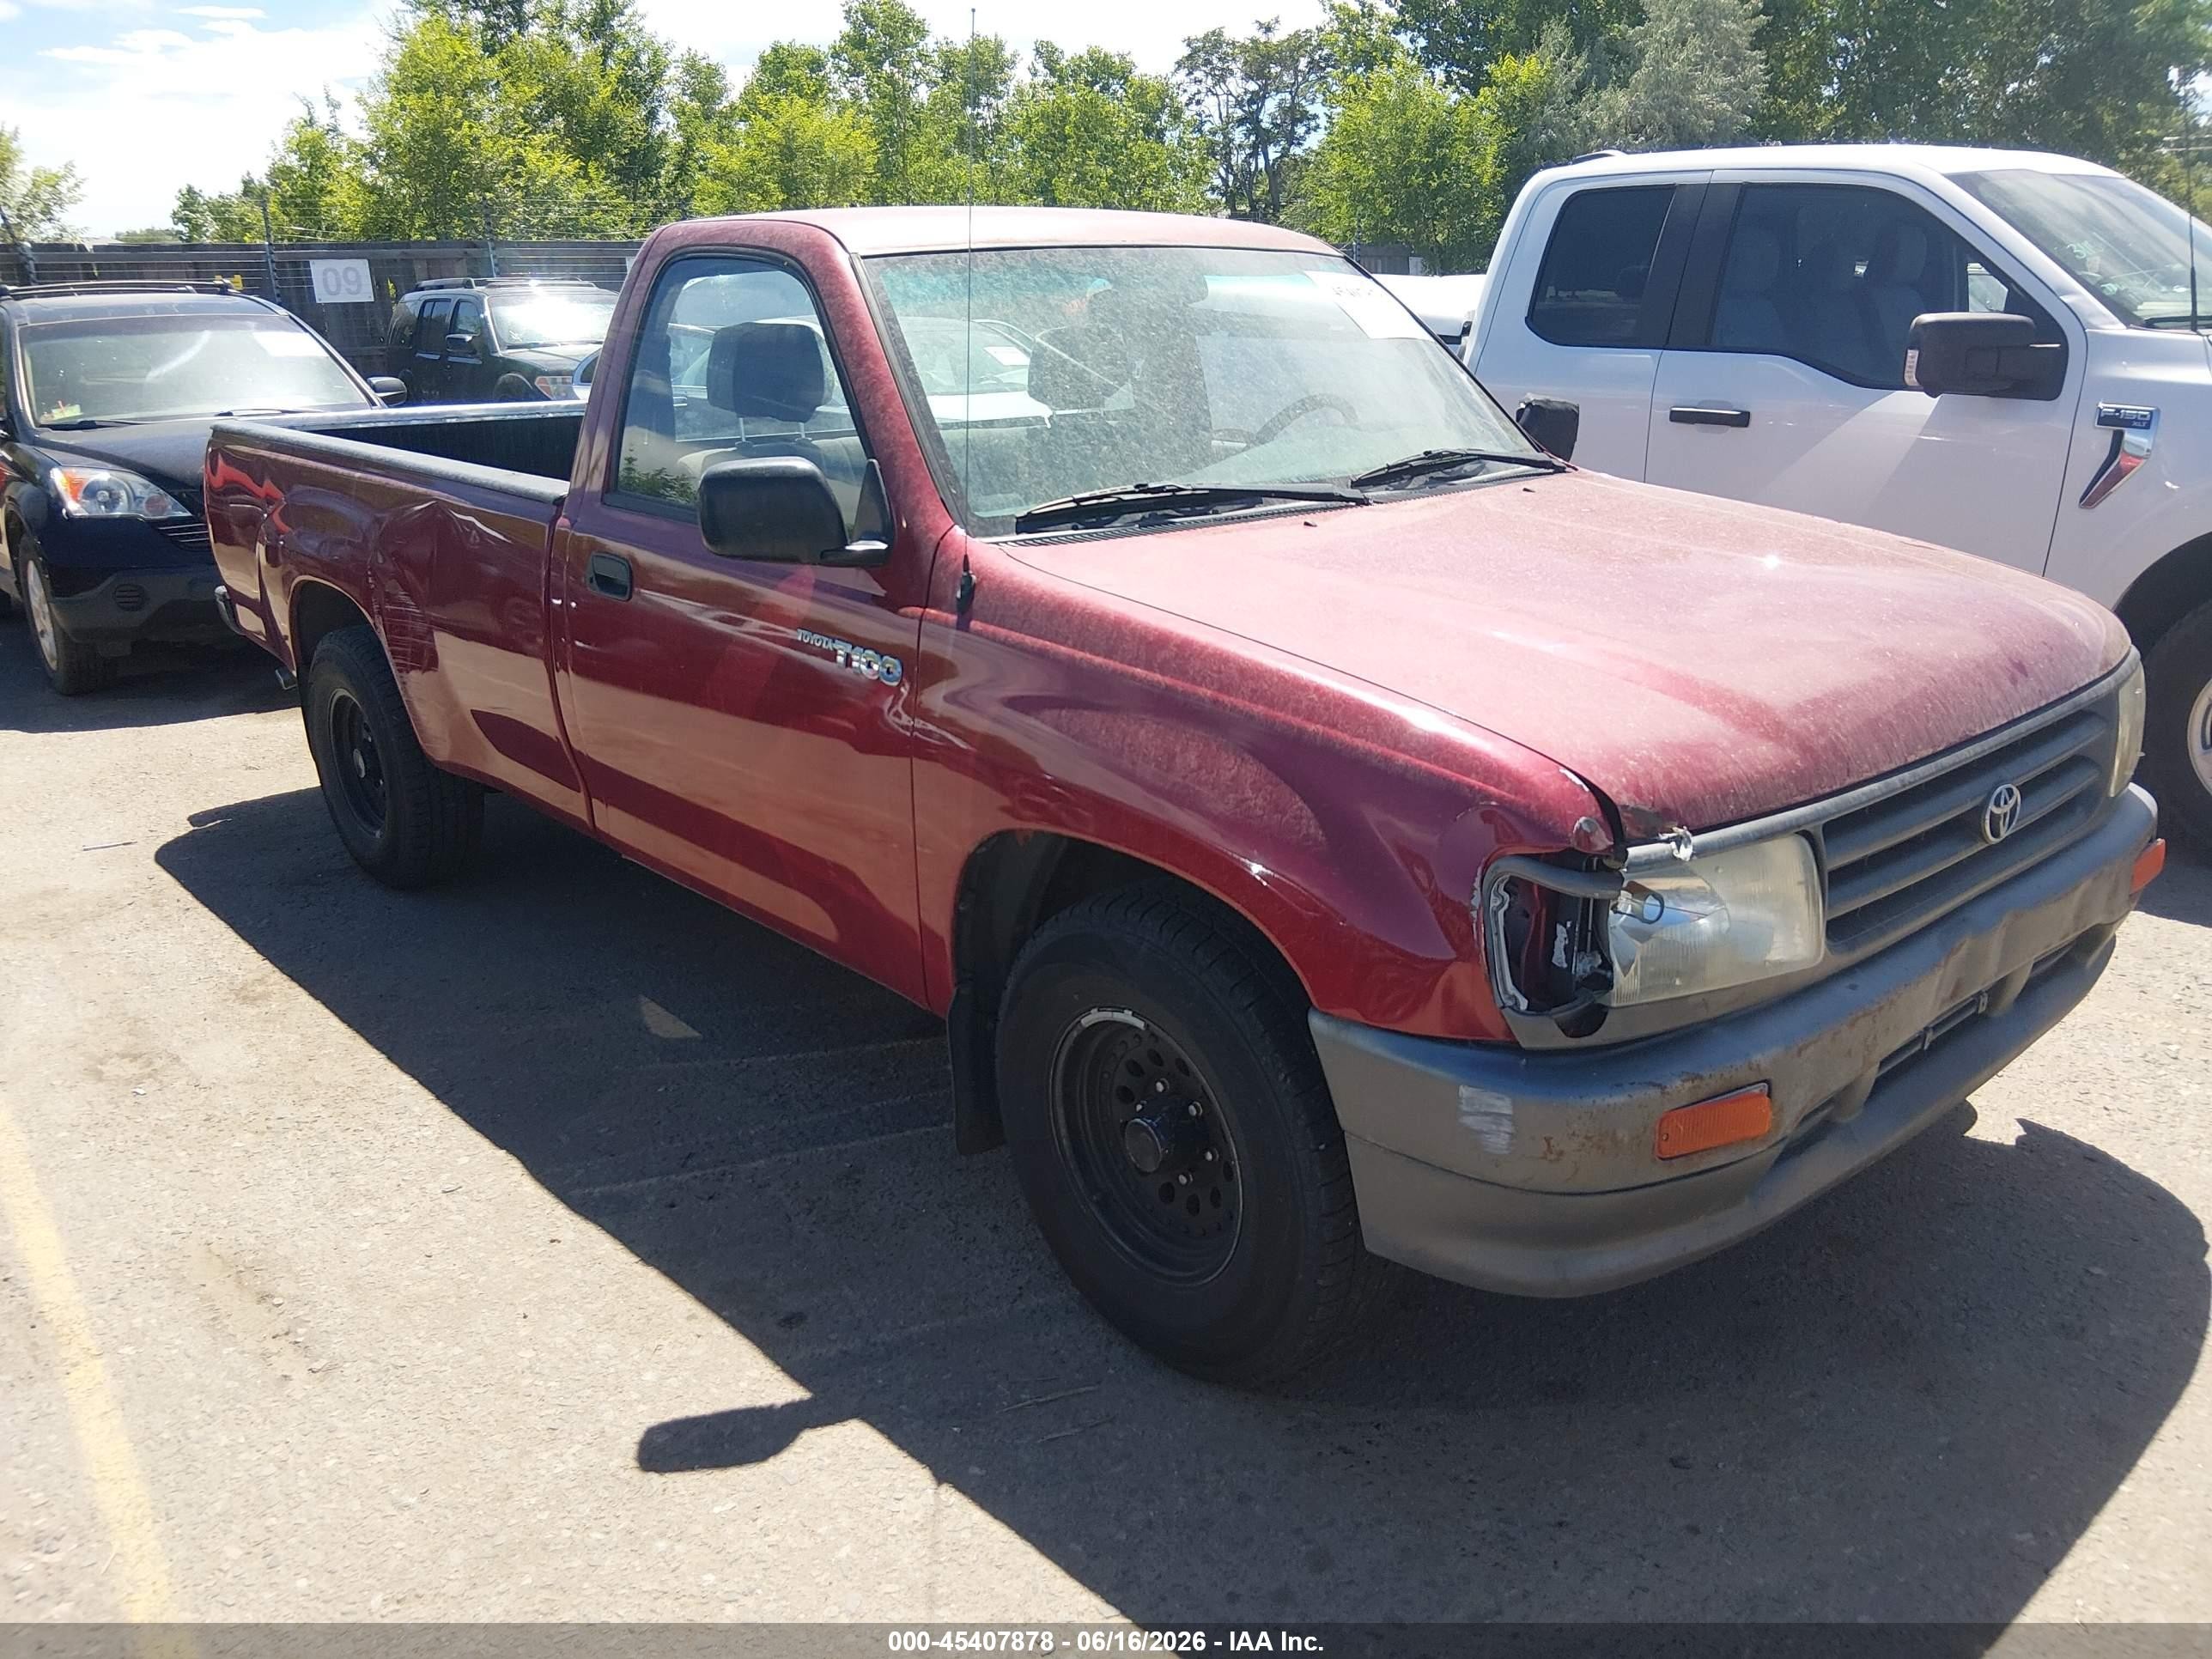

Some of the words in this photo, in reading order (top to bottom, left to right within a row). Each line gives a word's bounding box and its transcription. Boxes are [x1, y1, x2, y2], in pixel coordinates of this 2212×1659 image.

[322, 266, 362, 296] 09
[2100, 408, 2150, 421] F-150
[796, 628, 834, 652] TOYOTA
[833, 639, 902, 687] T100
